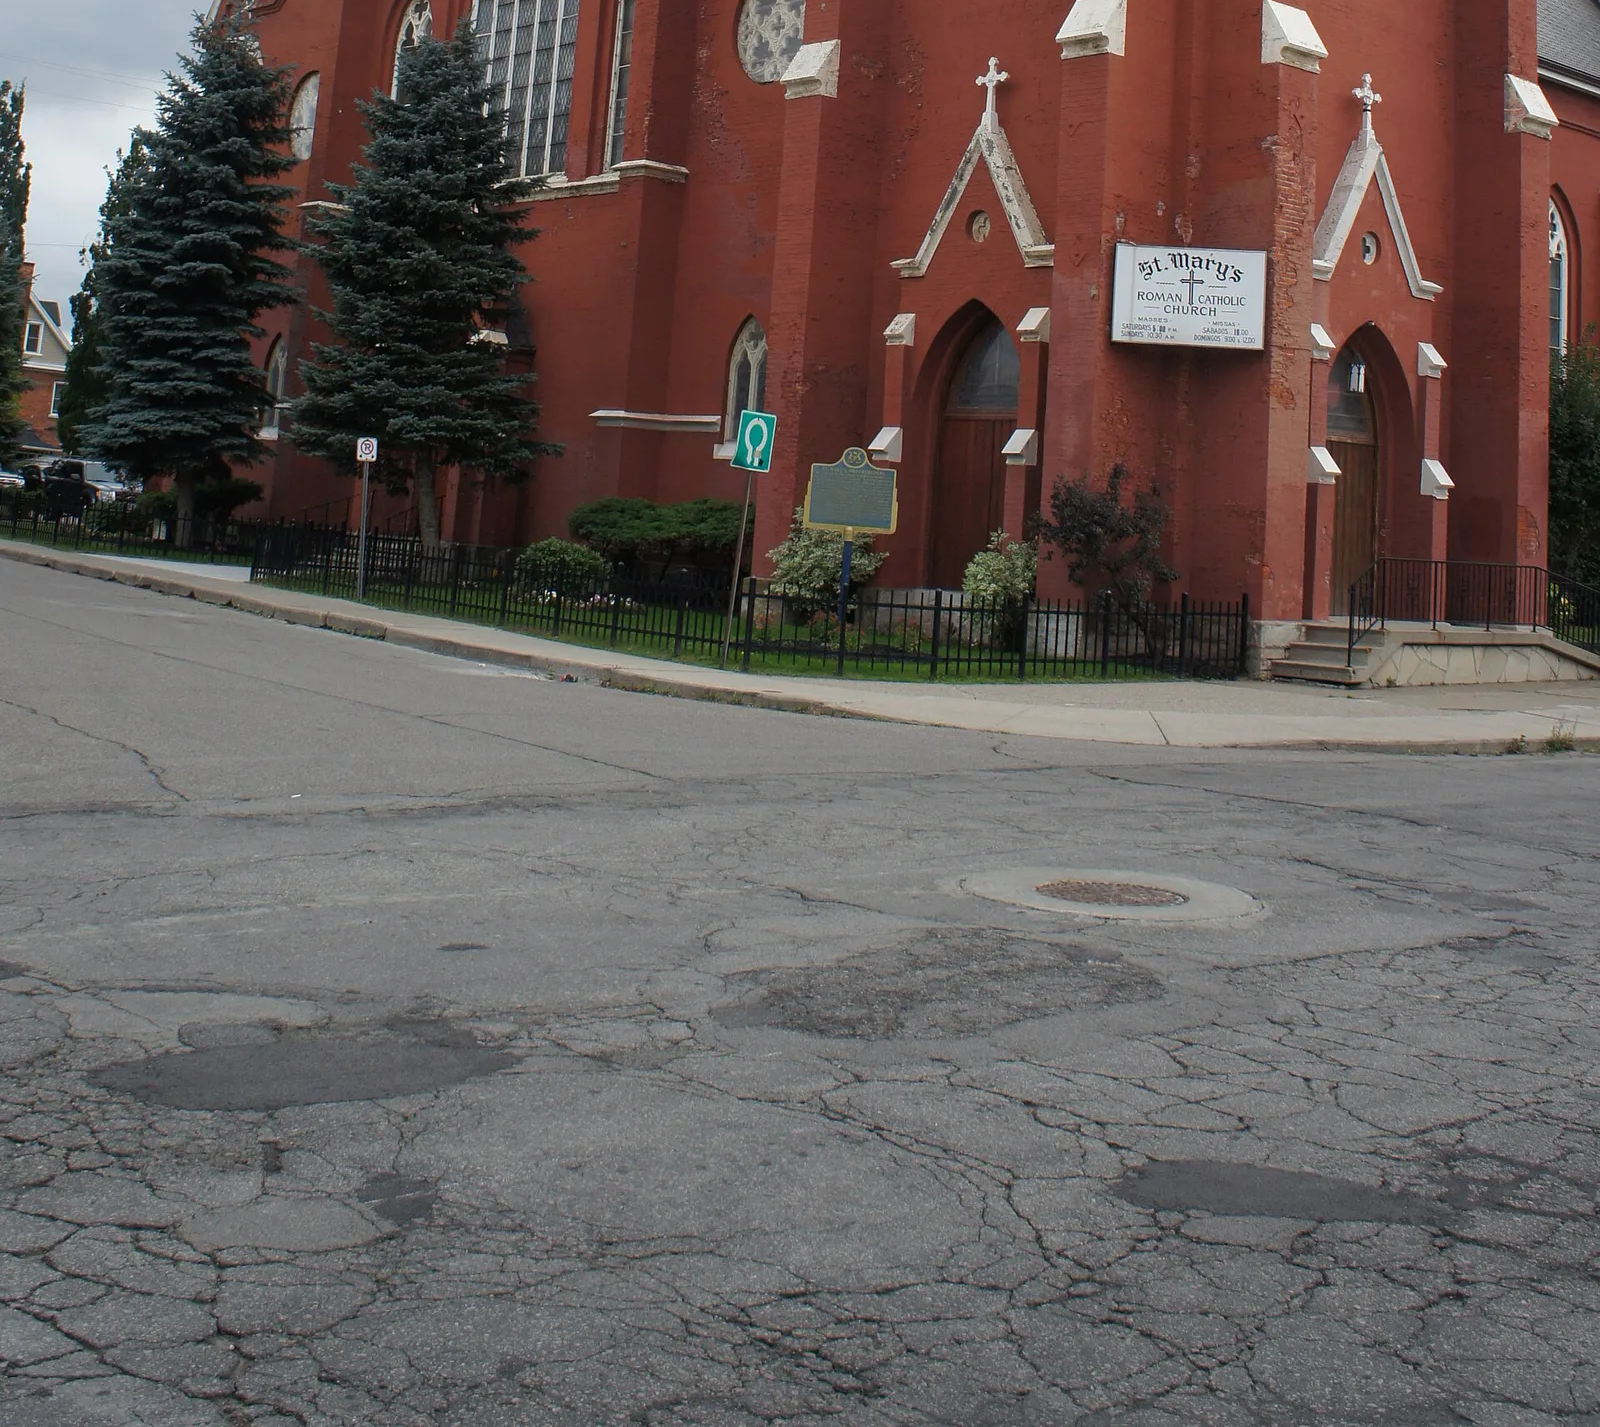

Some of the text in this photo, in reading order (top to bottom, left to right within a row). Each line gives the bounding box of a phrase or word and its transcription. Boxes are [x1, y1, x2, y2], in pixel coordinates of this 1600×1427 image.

[1138, 252, 1244, 283] St. Mary's
[1137, 291, 1246, 306] ROMAN CATHOLIC
[1164, 304, 1217, 316] CHURCH
[1121, 323, 1151, 331] SATURDAYS
[1194, 334, 1221, 342] DOMINGOS
